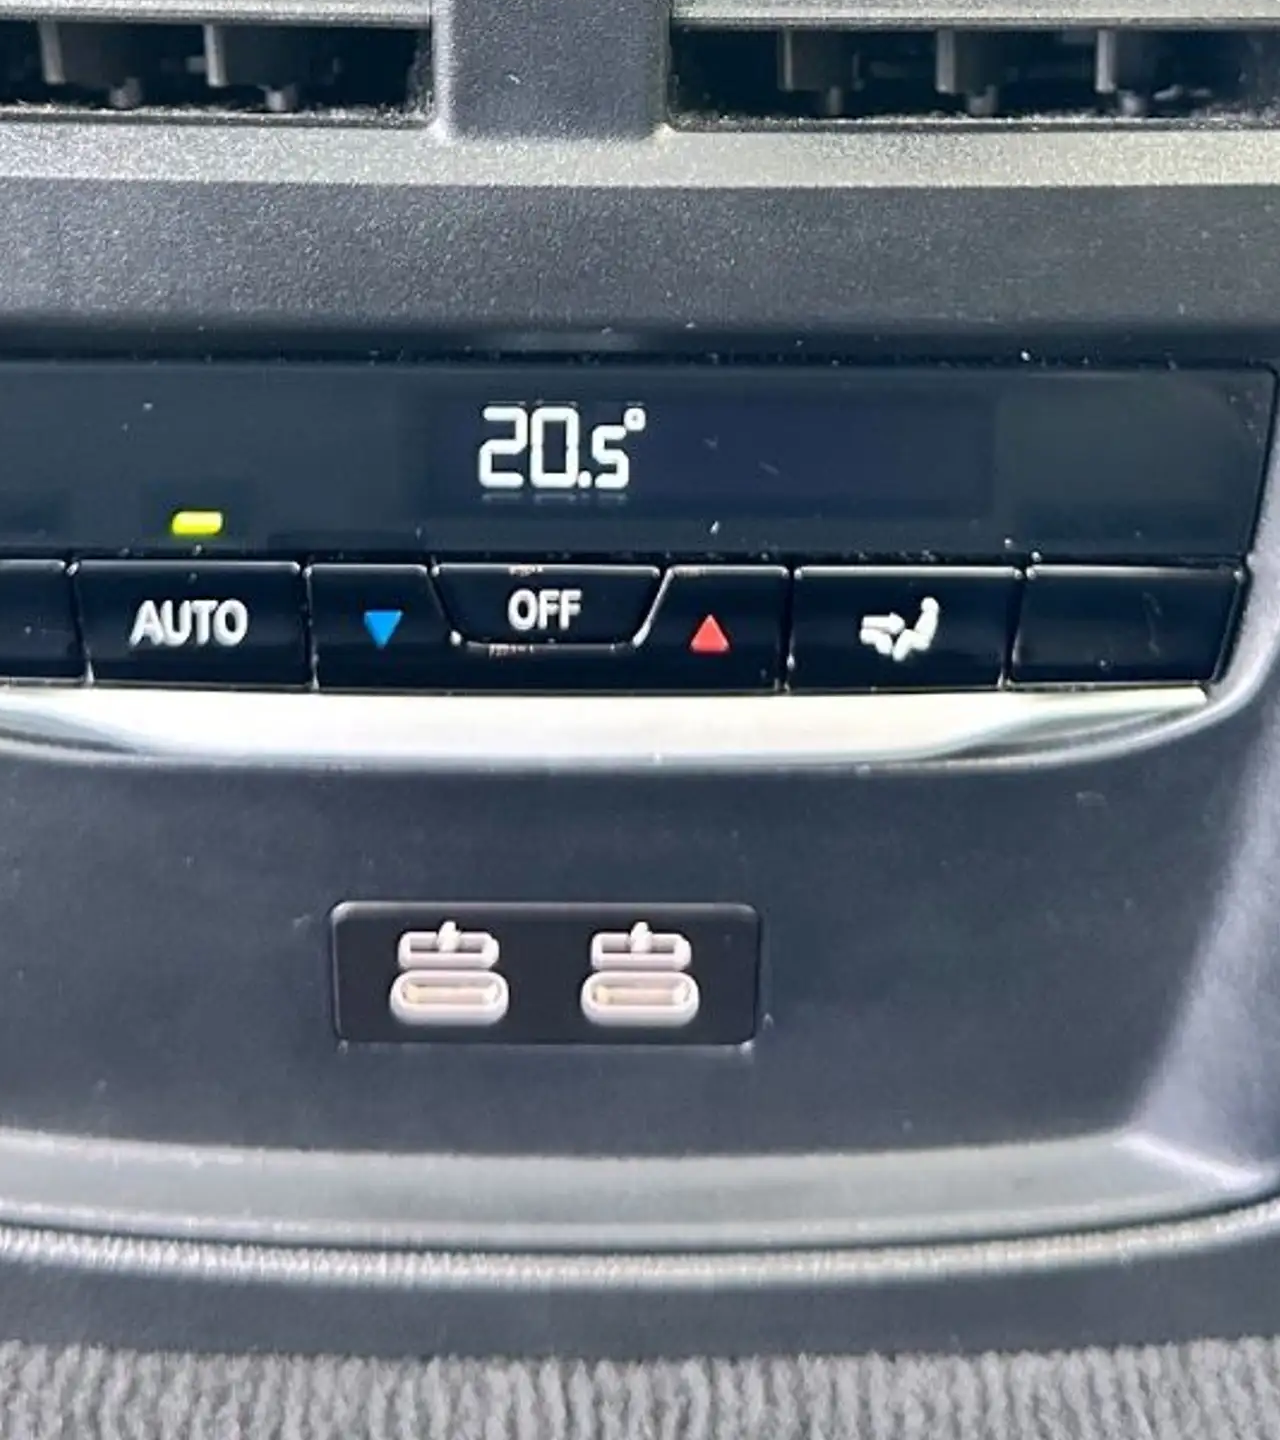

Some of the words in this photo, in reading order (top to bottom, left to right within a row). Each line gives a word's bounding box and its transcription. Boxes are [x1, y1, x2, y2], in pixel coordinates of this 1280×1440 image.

[478, 405, 646, 489] 20.5°
[129, 599, 248, 647] AUTO
[508, 589, 582, 631] OFF
